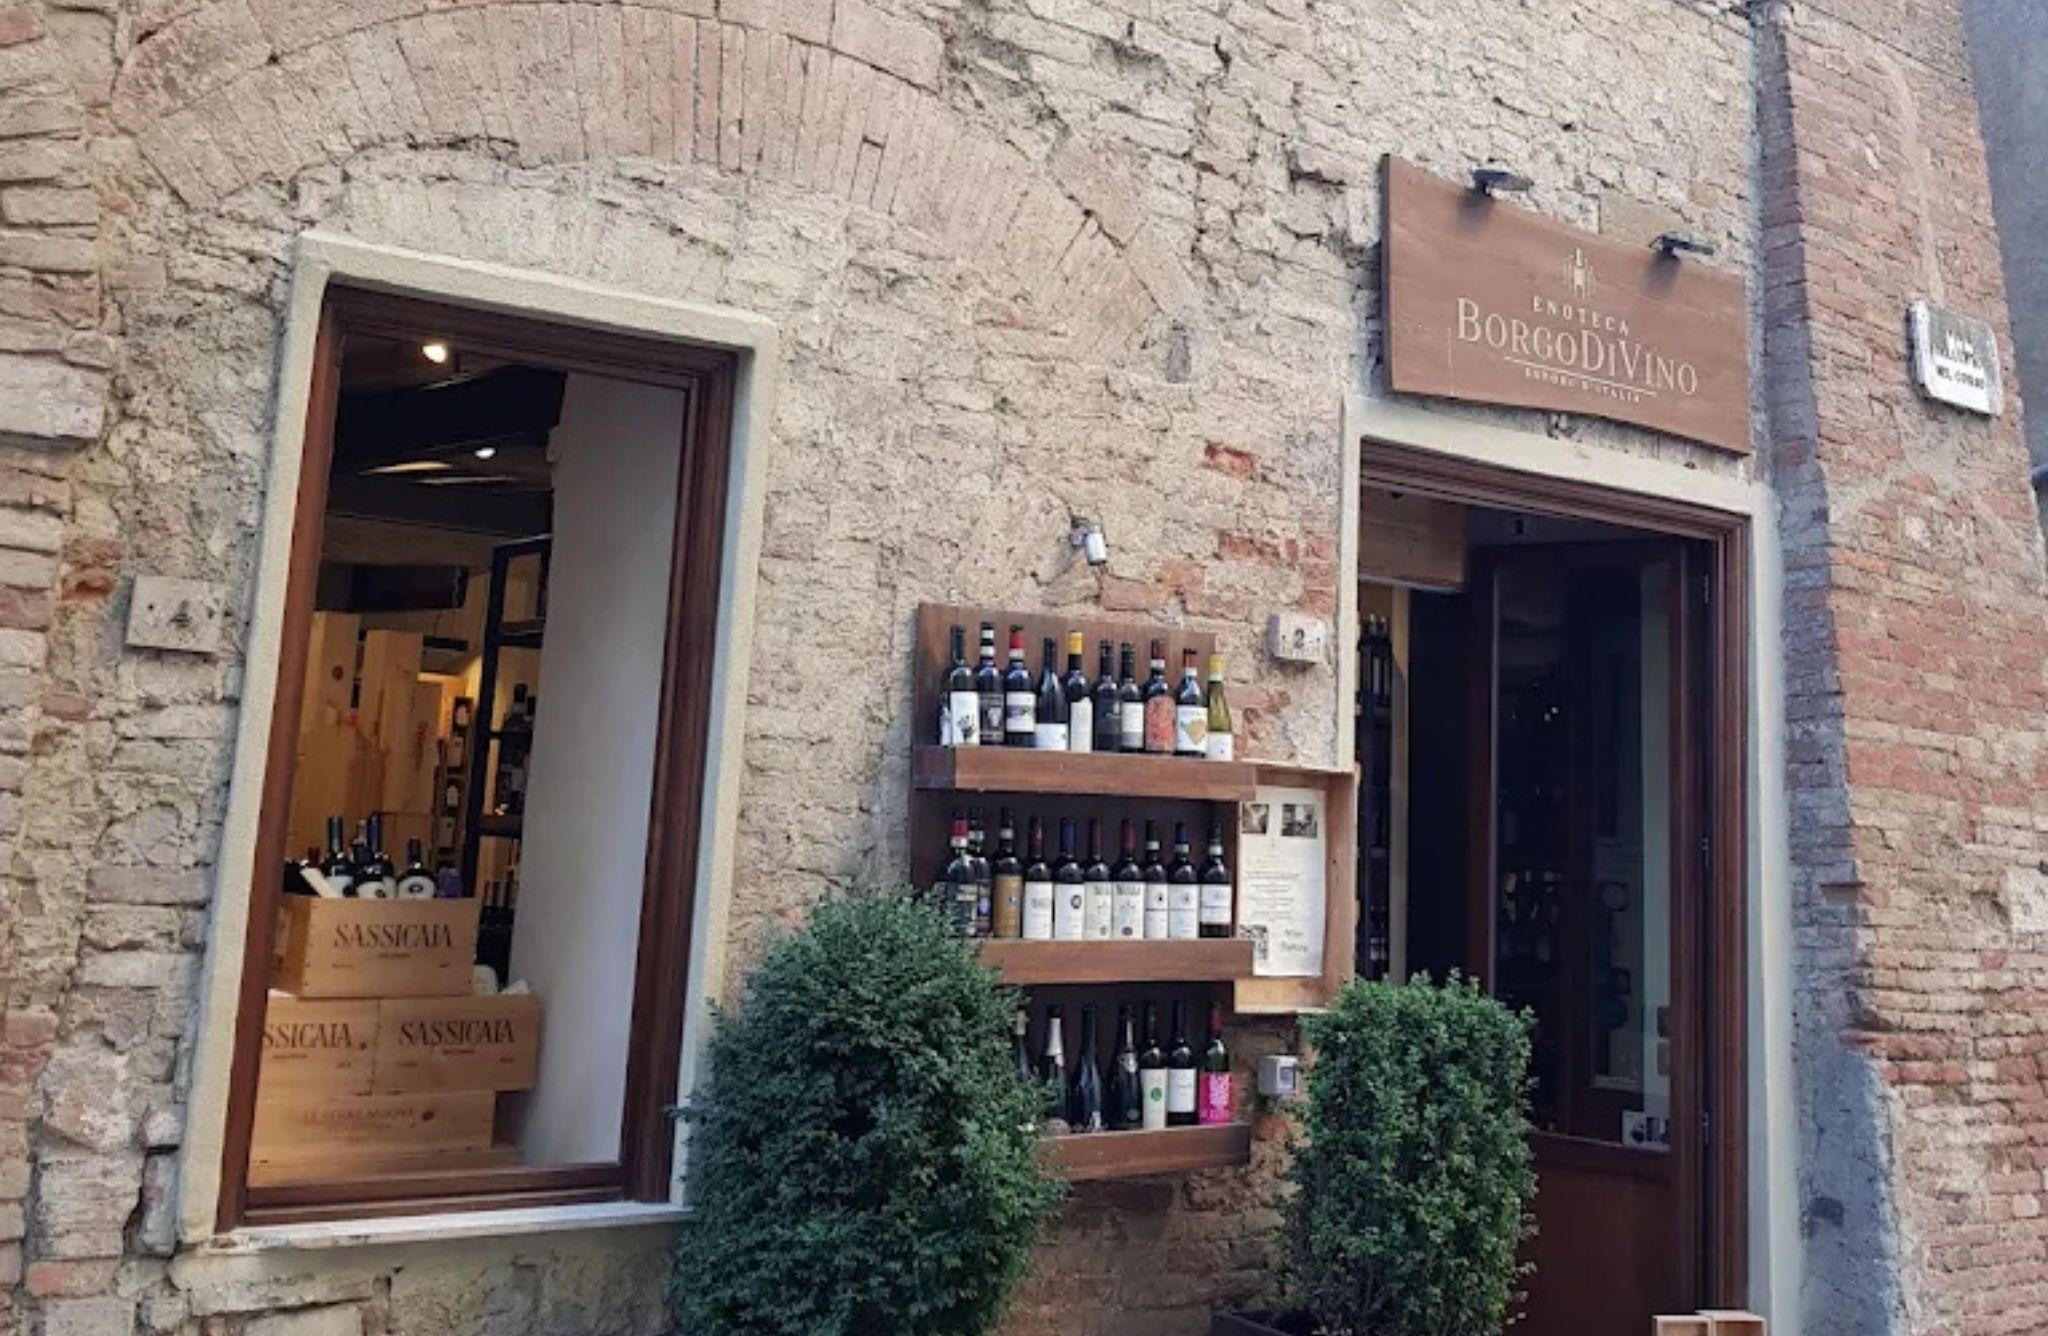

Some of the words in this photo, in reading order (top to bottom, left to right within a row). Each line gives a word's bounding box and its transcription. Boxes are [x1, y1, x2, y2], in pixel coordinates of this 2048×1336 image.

[1533, 296, 1630, 335] ENOTECA
[334, 923, 453, 947] SASSICAIA
[263, 1022, 352, 1048] SSICAIA
[398, 1019, 515, 1047] SASSICAIA
